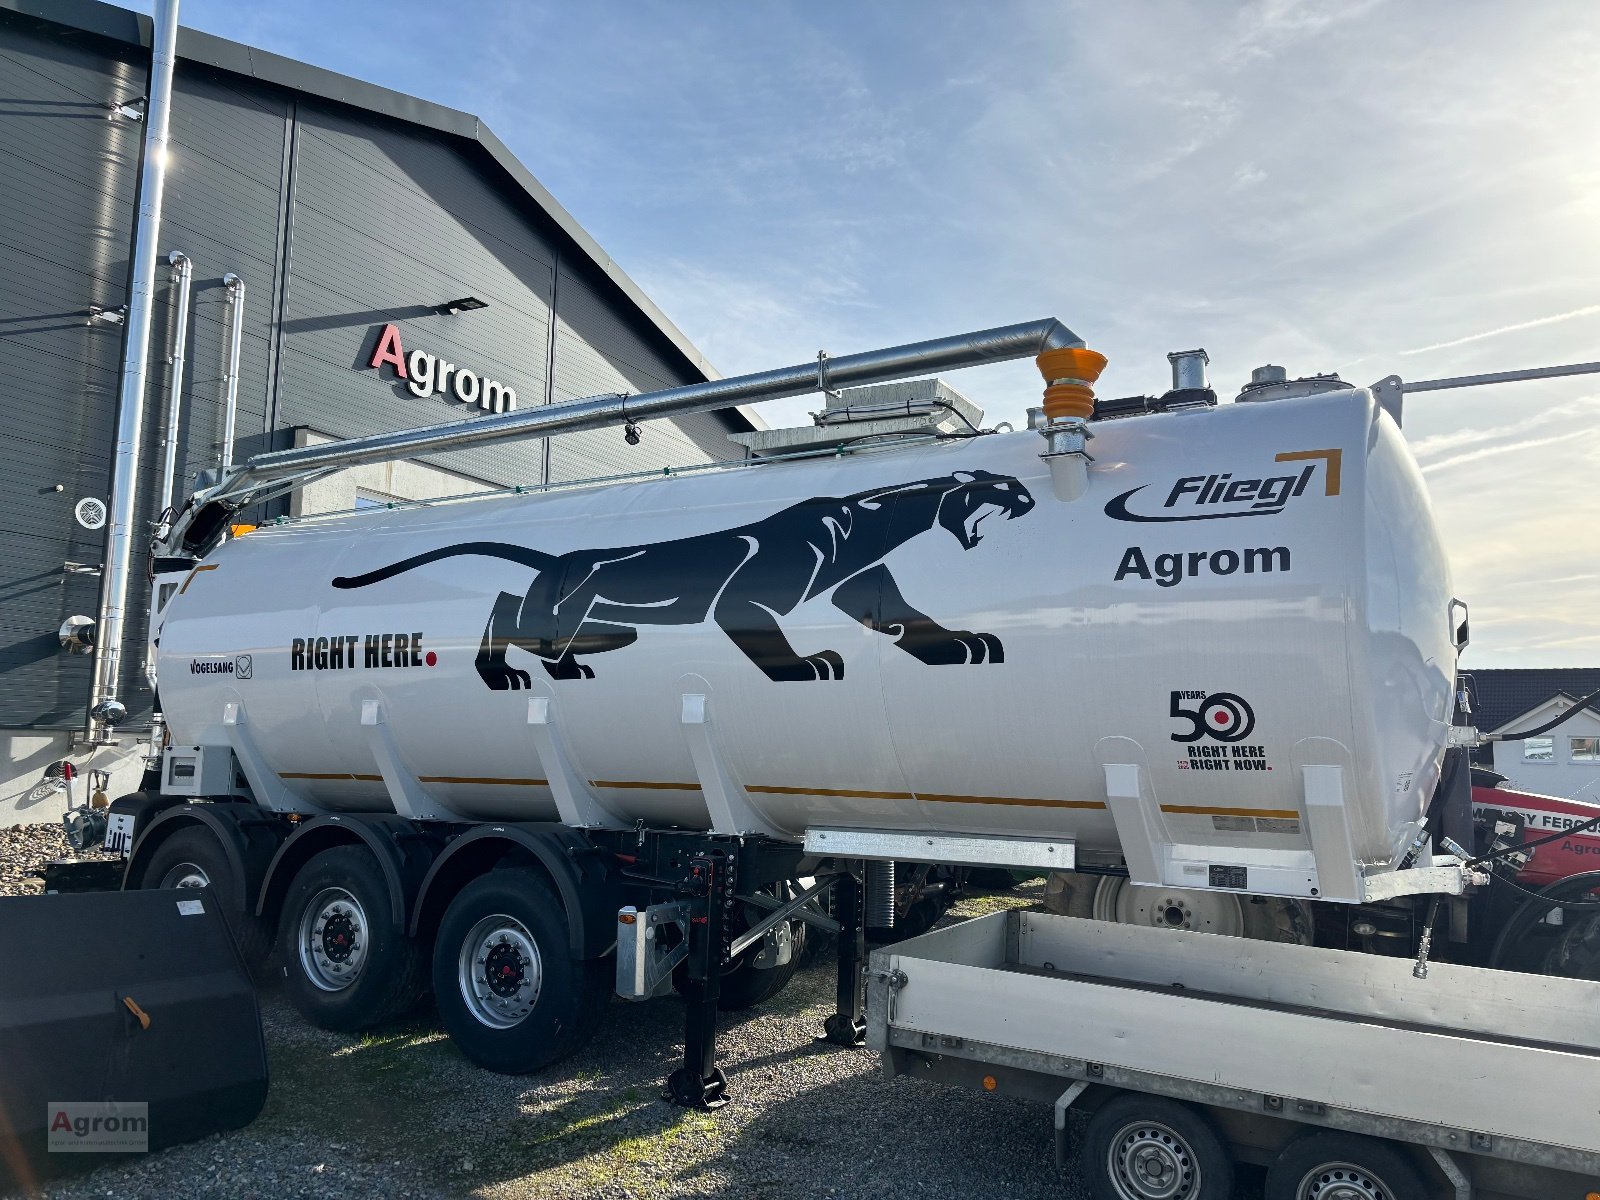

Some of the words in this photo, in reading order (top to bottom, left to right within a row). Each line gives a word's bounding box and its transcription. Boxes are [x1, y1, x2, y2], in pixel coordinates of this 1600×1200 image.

[370, 323, 517, 414] Agrom
[1163, 464, 1316, 509] Fliegl
[1113, 546, 1291, 587] Agrom
[190, 658, 234, 674] VOGELSANG
[291, 635, 359, 671] RIGHT
[1180, 690, 1207, 700] YEARS
[1170, 690, 1256, 743] 50
[1187, 745, 1228, 758] RIGHT
[1231, 745, 1266, 758] HERE
[1189, 759, 1231, 771] RIGHT
